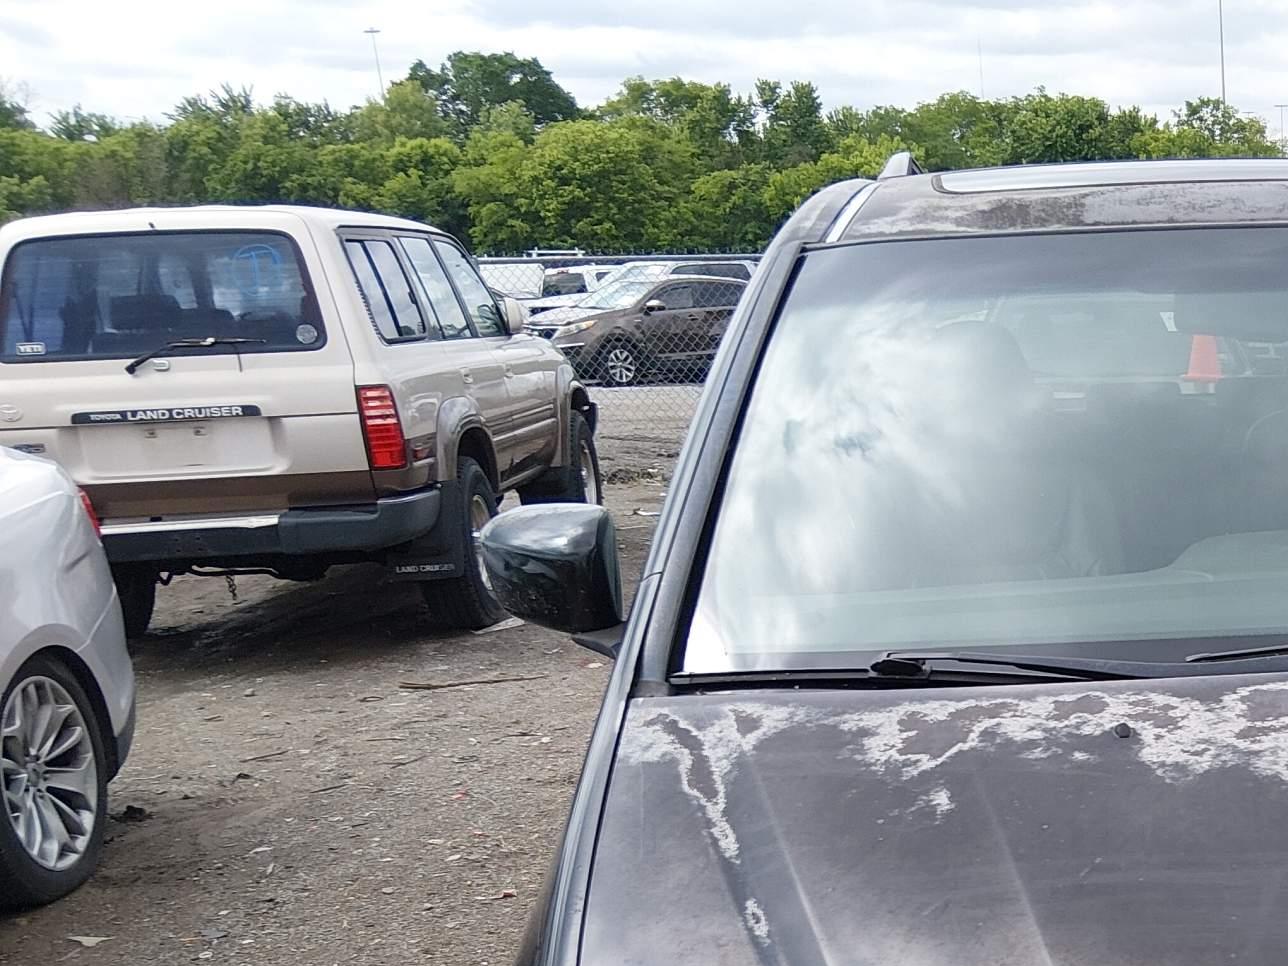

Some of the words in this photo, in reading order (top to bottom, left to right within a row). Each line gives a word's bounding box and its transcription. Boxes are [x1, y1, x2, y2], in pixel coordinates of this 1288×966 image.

[89, 413, 122, 421] TOYOTA
[127, 409, 170, 421] LAND
[173, 406, 243, 418] CRUISER
